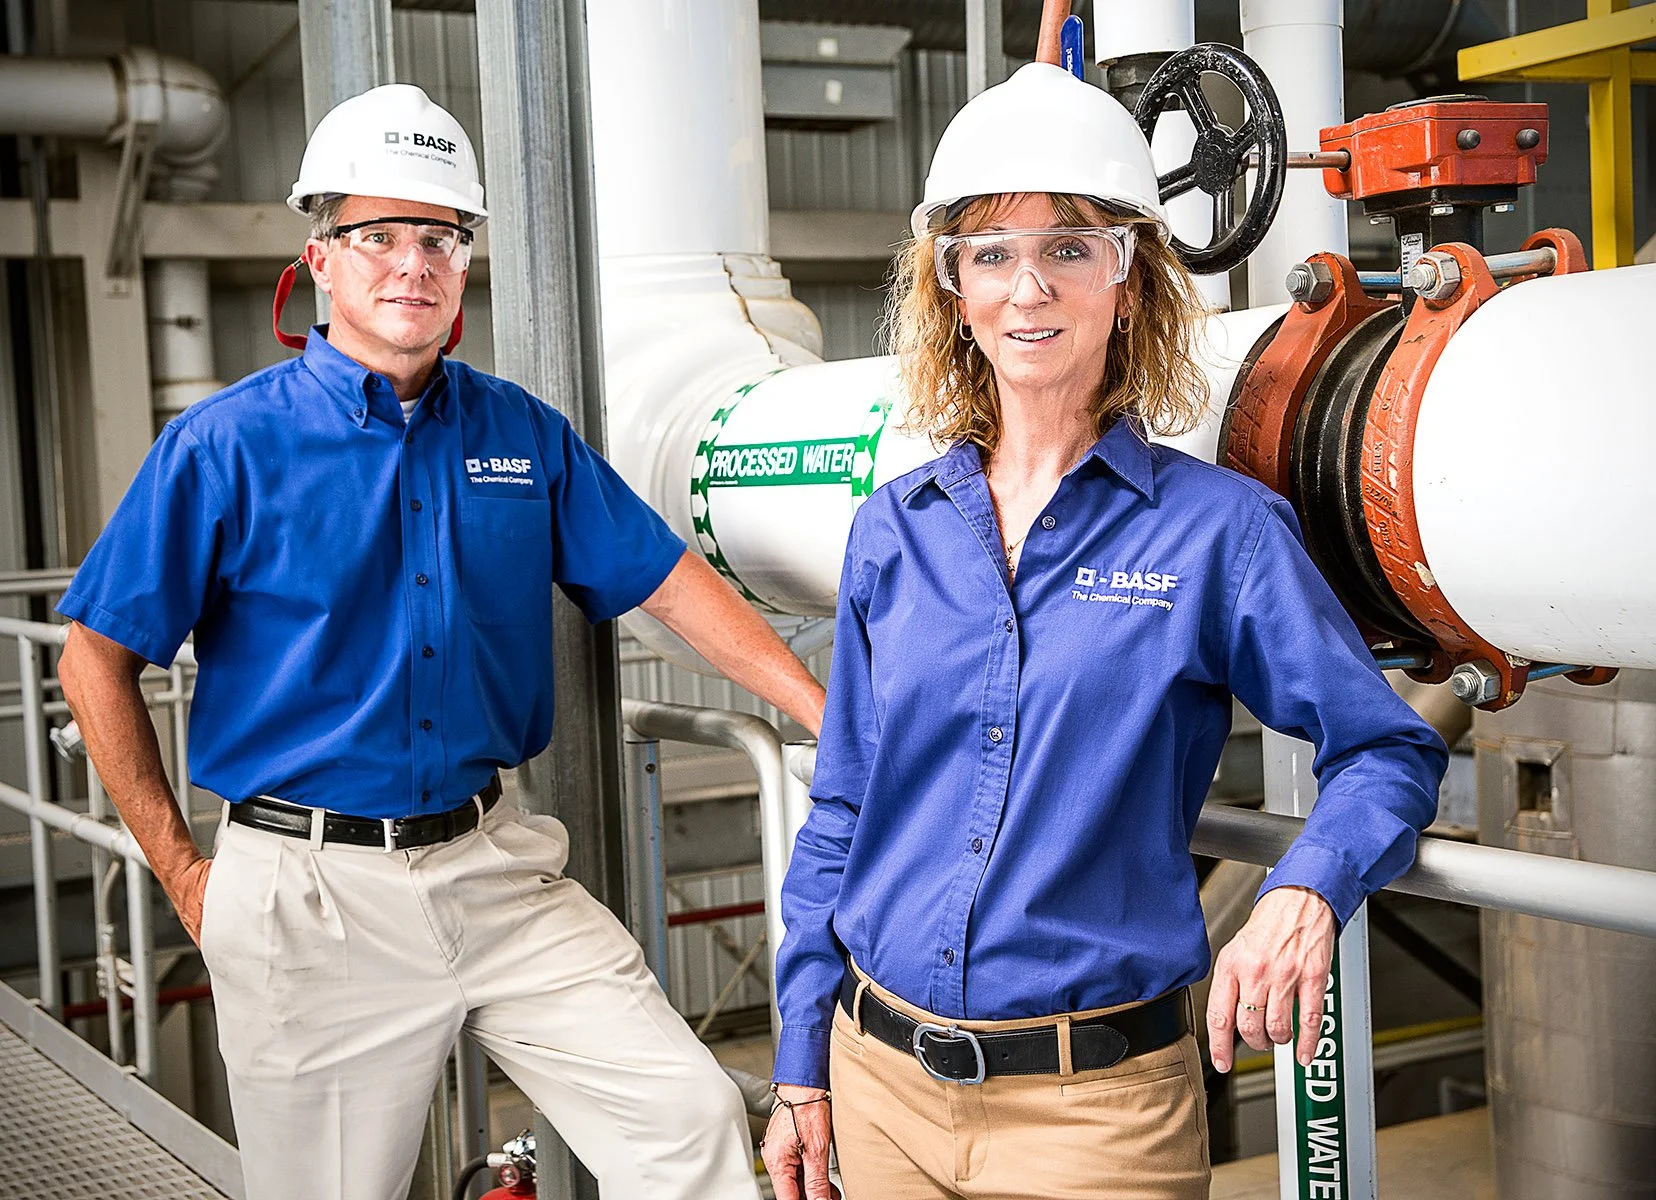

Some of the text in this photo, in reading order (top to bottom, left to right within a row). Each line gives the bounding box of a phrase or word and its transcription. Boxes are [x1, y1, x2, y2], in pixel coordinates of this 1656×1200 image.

[413, 133, 456, 154] BASF
[400, 149, 429, 159] Chemical
[431, 154, 456, 168] Company
[489, 458, 531, 474] BASF
[709, 442, 856, 478] PROCESSED WATER
[483, 475, 508, 483] Chemical
[509, 477, 534, 486] Company
[1110, 571, 1178, 592] BASF
[1072, 590, 1174, 611] The Chemical Company
